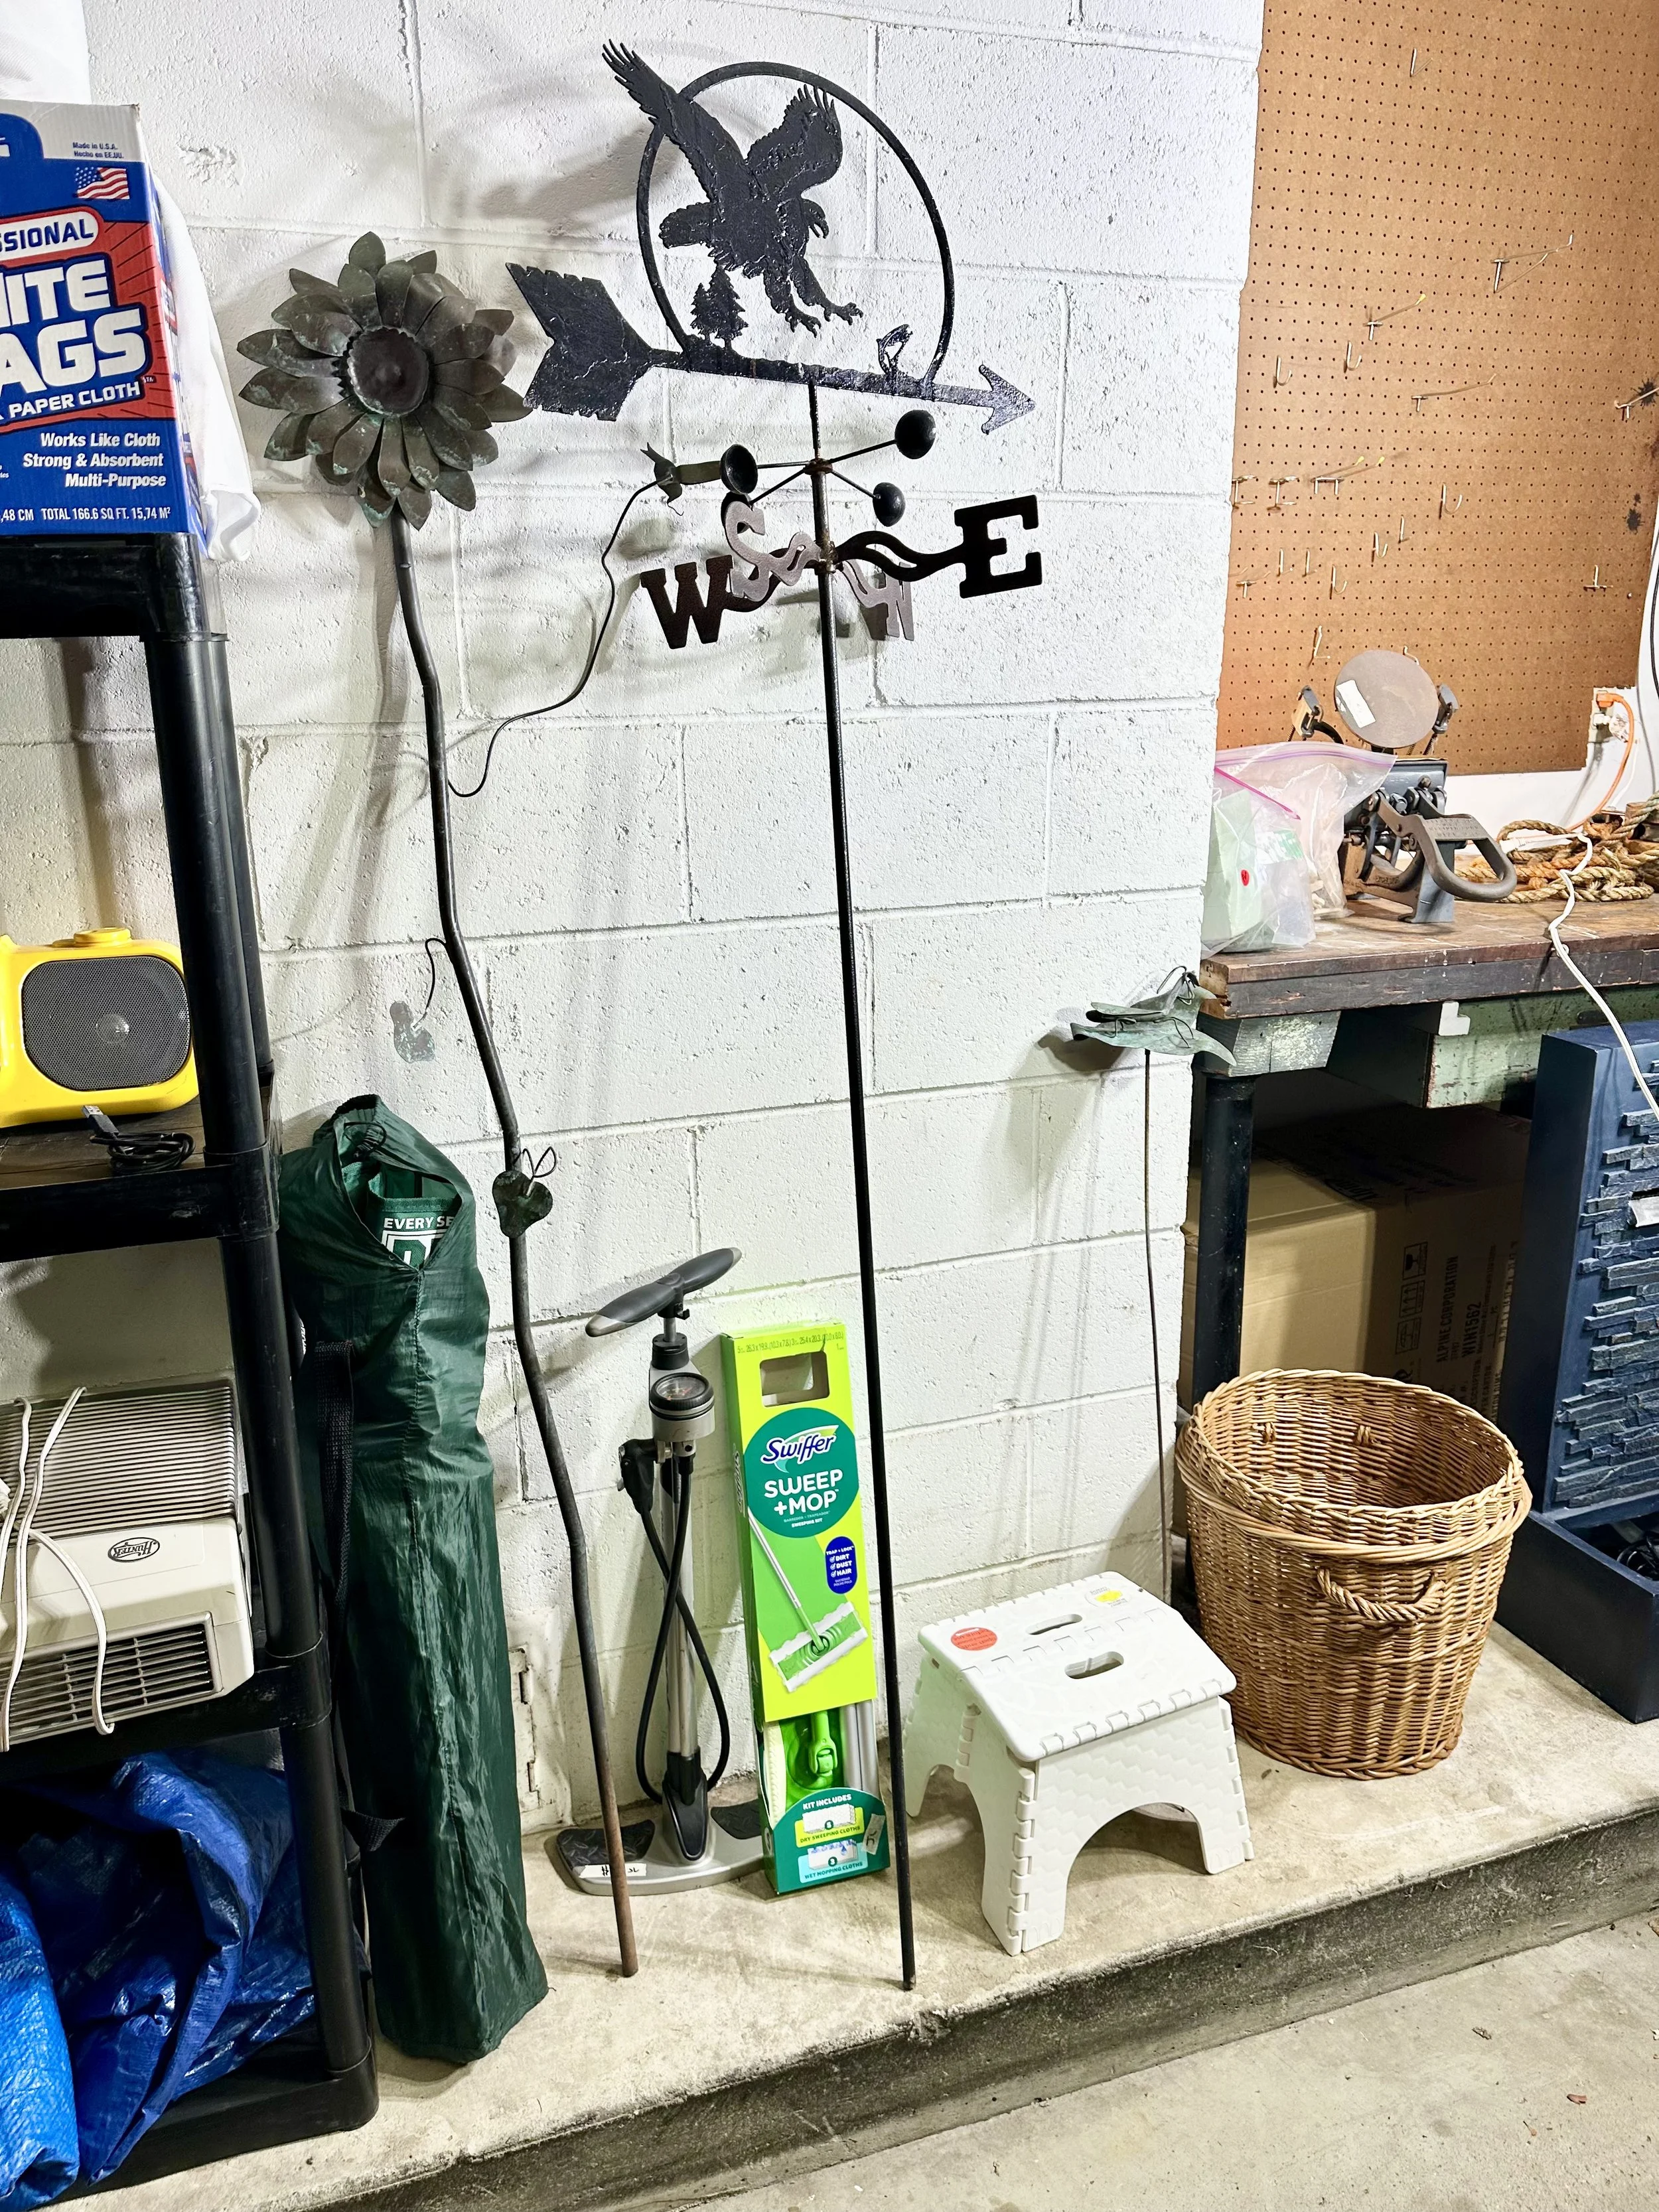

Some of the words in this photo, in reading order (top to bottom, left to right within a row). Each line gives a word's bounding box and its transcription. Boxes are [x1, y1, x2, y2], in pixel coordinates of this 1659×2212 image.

[9, 394, 75, 419] PAPER
[78, 381, 141, 405] CLOTH
[40, 433, 86, 447] Works
[90, 433, 120, 447] Like
[124, 433, 161, 447] Cloth
[23, 453, 72, 470] Strong
[76, 453, 87, 467] &
[90, 453, 164, 467] Absorbent
[65, 473, 167, 489] Multi-Purpose
[18, 508, 34, 521] CM
[40, 508, 70, 520] TOTAL
[73, 508, 99, 520] 166.6
[101, 508, 114, 520] SQ
[116, 507, 129, 520] FT.
[131, 507, 157, 521] 15,74
[954, 494, 1043, 599] E
[640, 554, 734, 650] W
[384, 1217, 434, 1229] EVERY
[1441, 1255, 1459, 1327] CORPORATION
[1461, 1301, 1481, 1358] WIN1562
[1436, 1327, 1451, 1362] ALPINE
[762, 1434, 835, 1463] Swiffer
[764, 1468, 843, 1498] SWEEP
[112, 1540, 157, 1559] HUNTER
[836, 1560, 852, 1569] DUST
[816, 1794, 852, 1806] INCLUDES
[812, 1830, 839, 1840] SWEEPING
[839, 1825, 861, 1834] CLOTHS
[817, 1866, 842, 1877] MOPPING
[842, 1861, 863, 1870] CLOTHS
